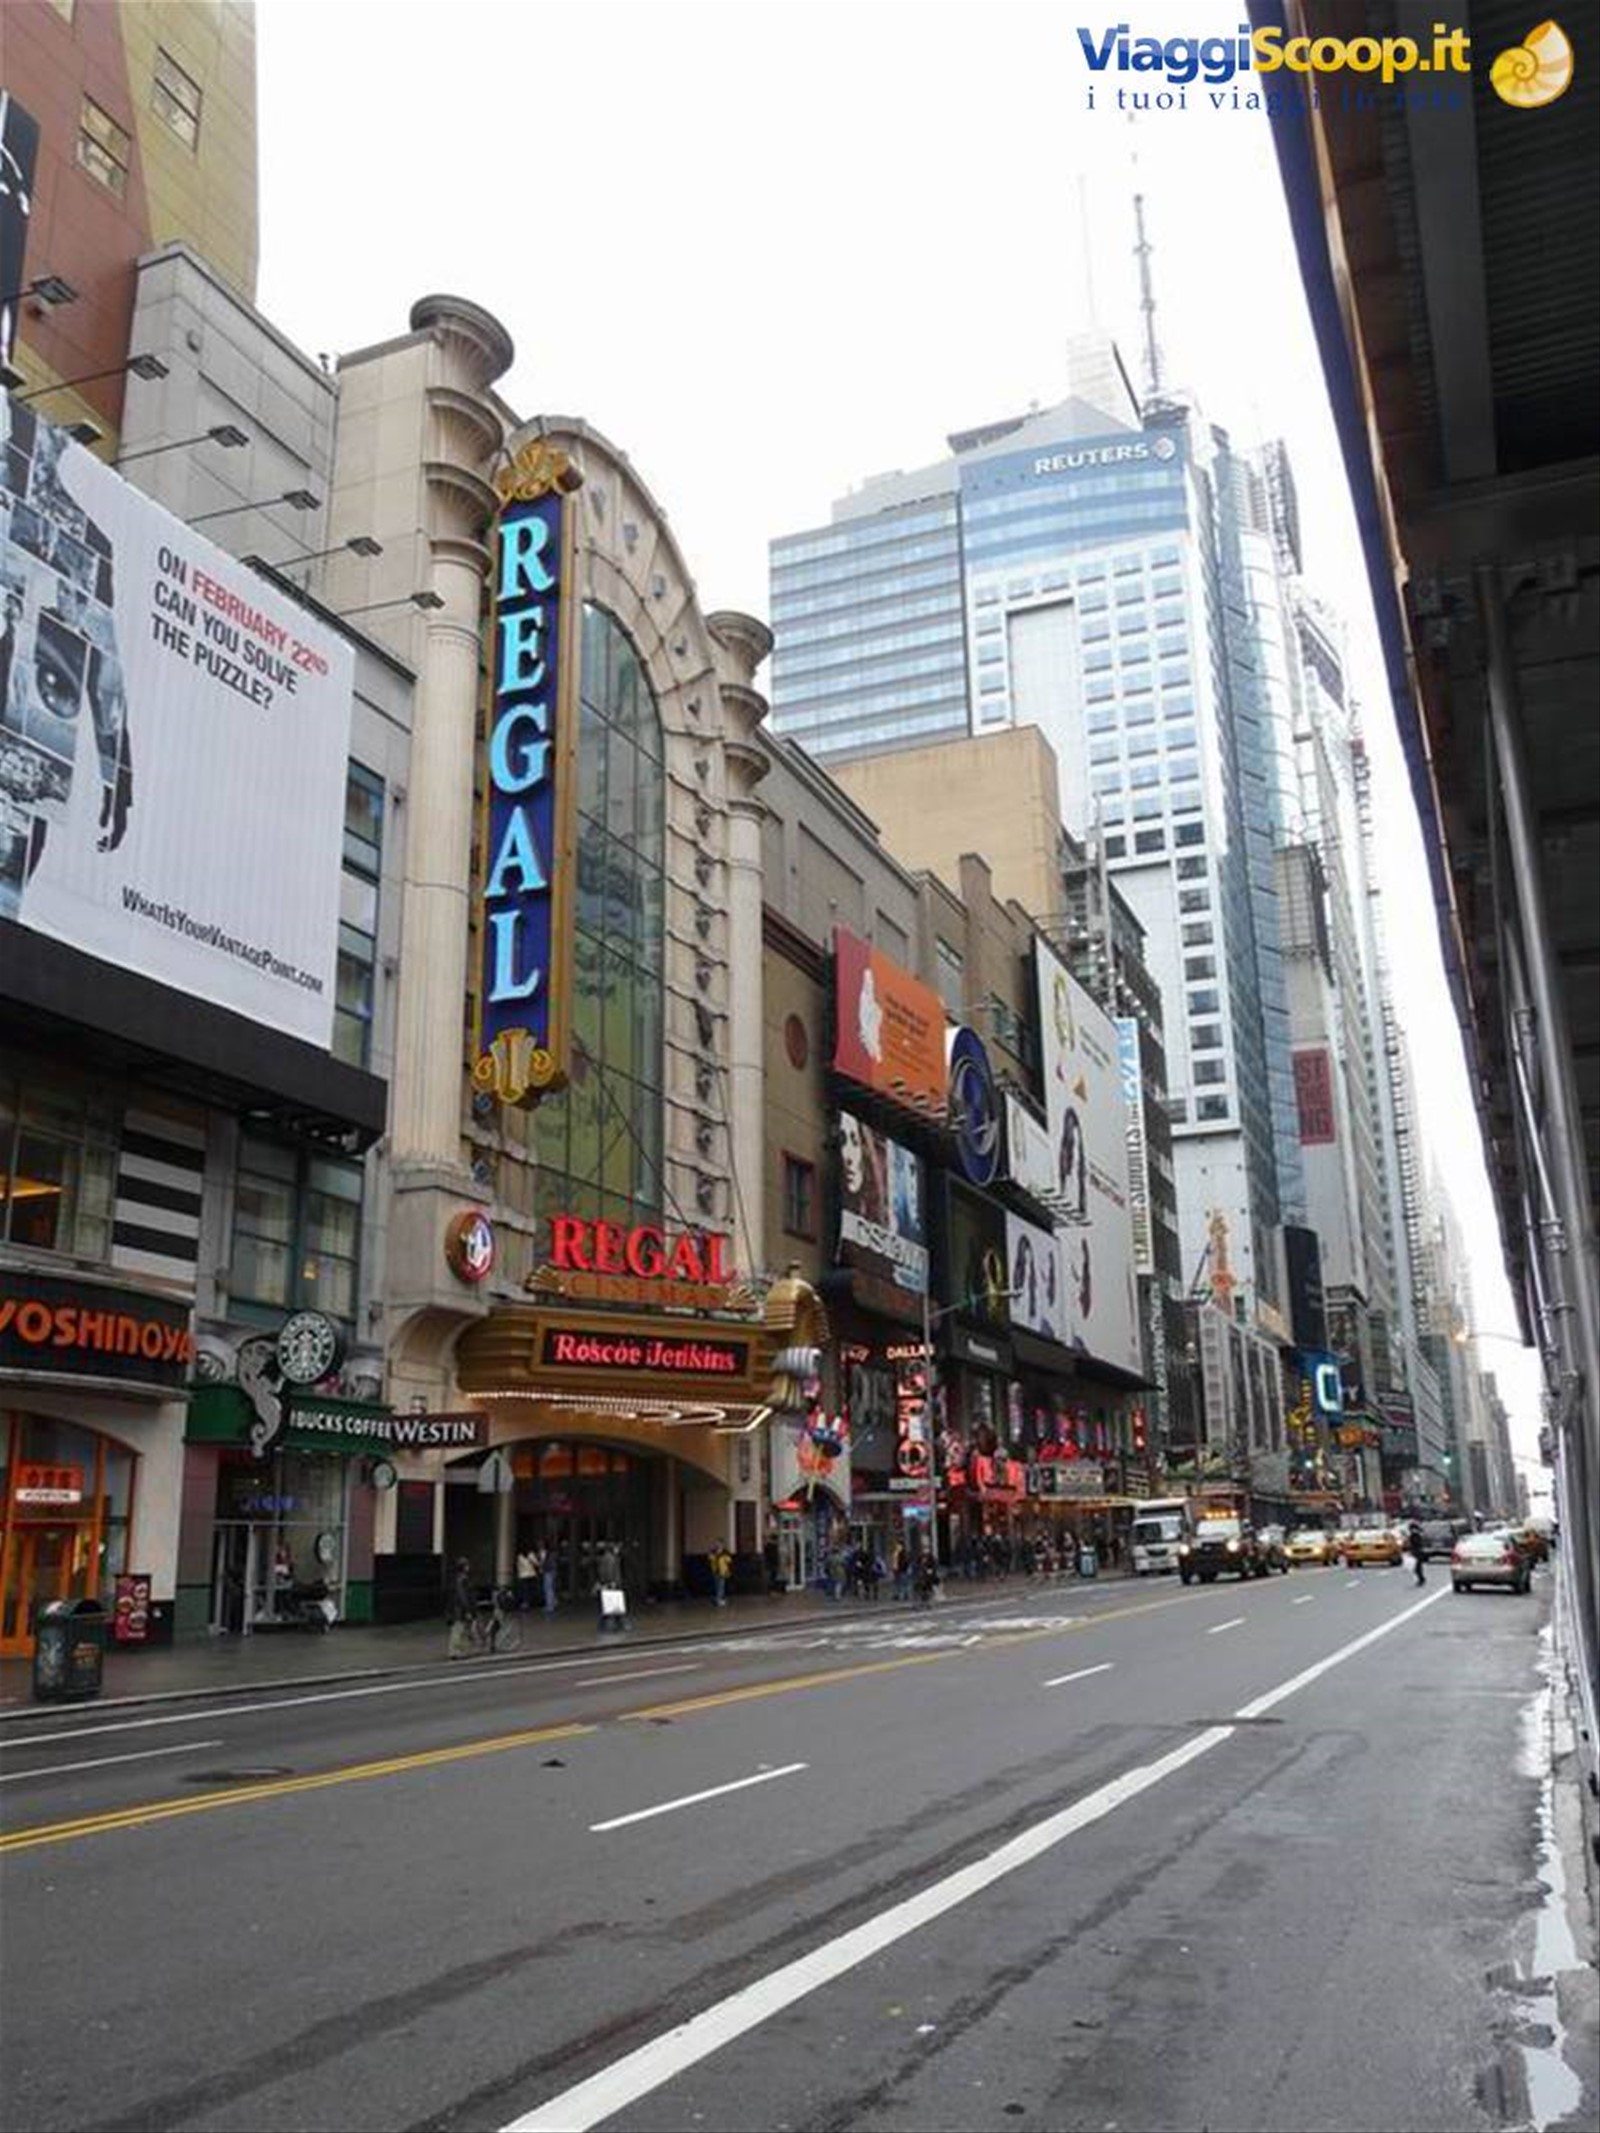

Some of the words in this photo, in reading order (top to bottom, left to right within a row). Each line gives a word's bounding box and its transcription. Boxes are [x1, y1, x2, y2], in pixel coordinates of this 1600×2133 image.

[1034, 442, 1149, 475] REUTERS
[154, 580, 197, 626] CAN
[202, 610, 240, 654] YOU
[242, 638, 298, 695] SOLVE
[157, 545, 187, 585] ON
[191, 569, 288, 652] FEBRUARY
[151, 612, 190, 659] THE
[194, 641, 275, 710] PUZZLE?
[484, 514, 556, 1003] REGAL
[549, 1213, 737, 1286] REGAL
[552, 1334, 641, 1366] Roscoe
[646, 1340, 736, 1372] Jenkins
[394, 1420, 476, 1443] WESTIN
